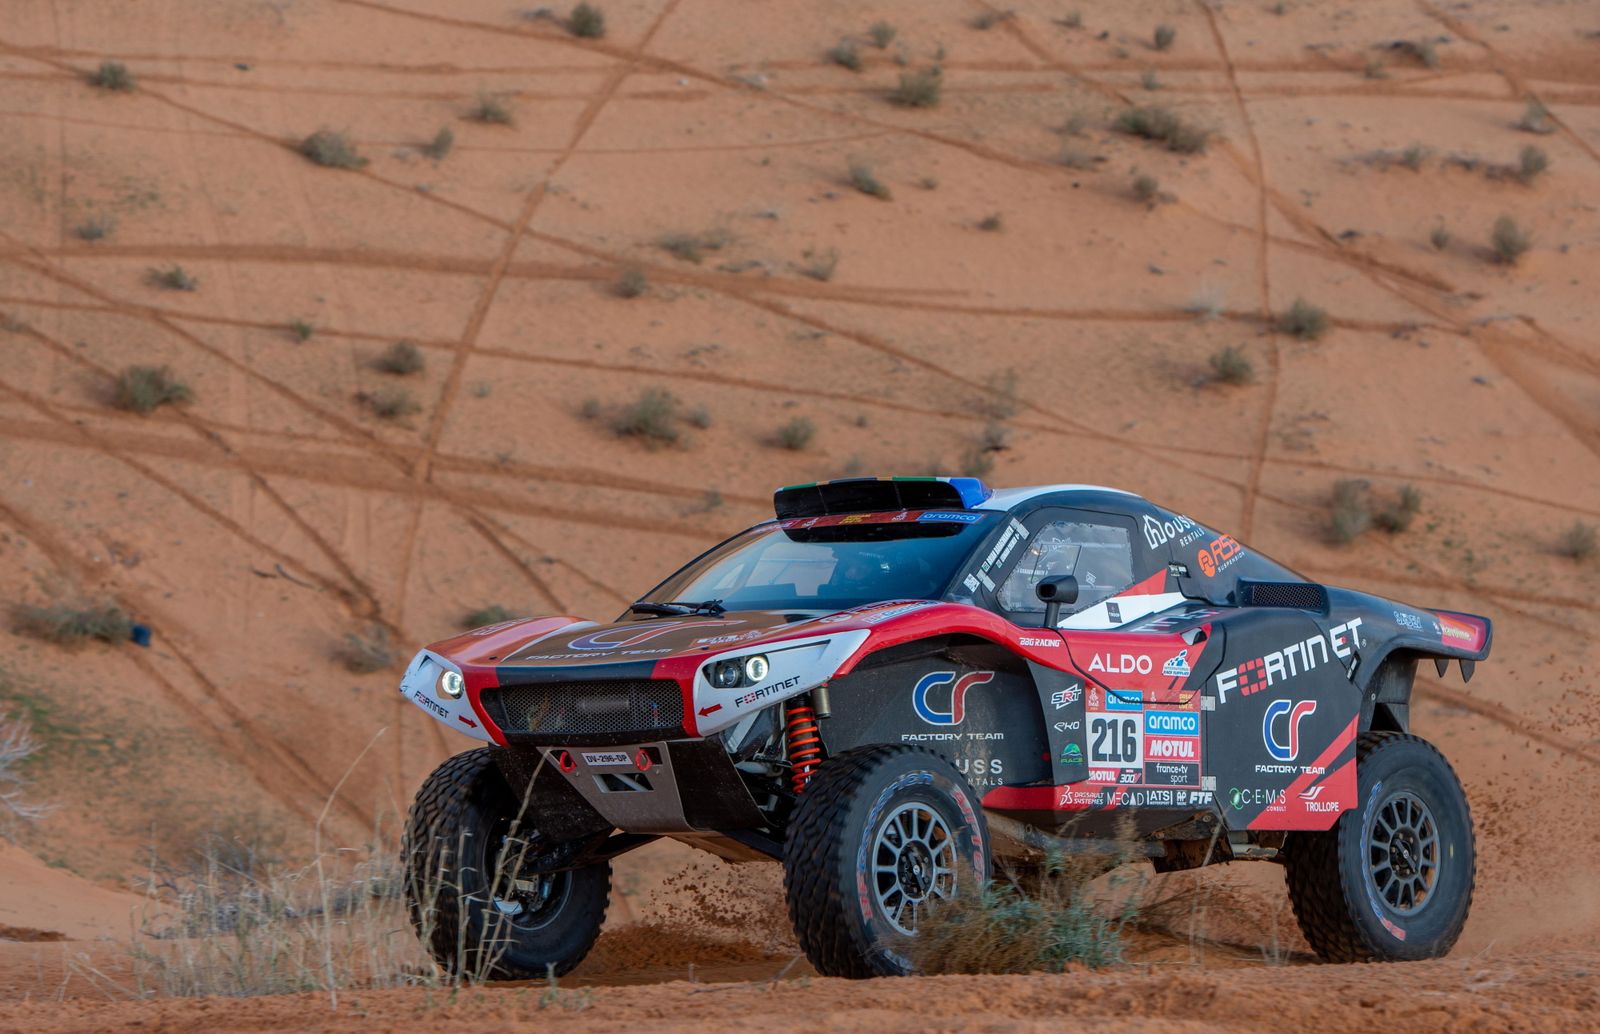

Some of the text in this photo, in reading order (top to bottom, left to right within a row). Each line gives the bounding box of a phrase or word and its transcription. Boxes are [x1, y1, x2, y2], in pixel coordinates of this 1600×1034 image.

[923, 512, 976, 521] aramco
[1180, 528, 1205, 548] RENTALS
[1035, 638, 1061, 648] RACING
[526, 651, 615, 660] FACTORY
[1216, 616, 1362, 704] FORTINET
[1088, 653, 1152, 675] ALDO
[735, 676, 800, 708] FORTINET
[1051, 687, 1082, 705] SRT
[414, 690, 449, 718] FORTINET
[1150, 715, 1196, 730] aramco
[1092, 718, 1136, 762] 216
[1150, 740, 1194, 757] MOTUL
[1088, 770, 1115, 781] MOTUL
[1255, 765, 1325, 774] FACTORY TEAM
[1120, 773, 1142, 783] 300V
[1170, 774, 1188, 785] sport
[1107, 792, 1144, 806] MECAD
[1150, 790, 1170, 801] ATS
[1190, 792, 1213, 804] FTF
[1305, 802, 1339, 812] TROLLOPE
